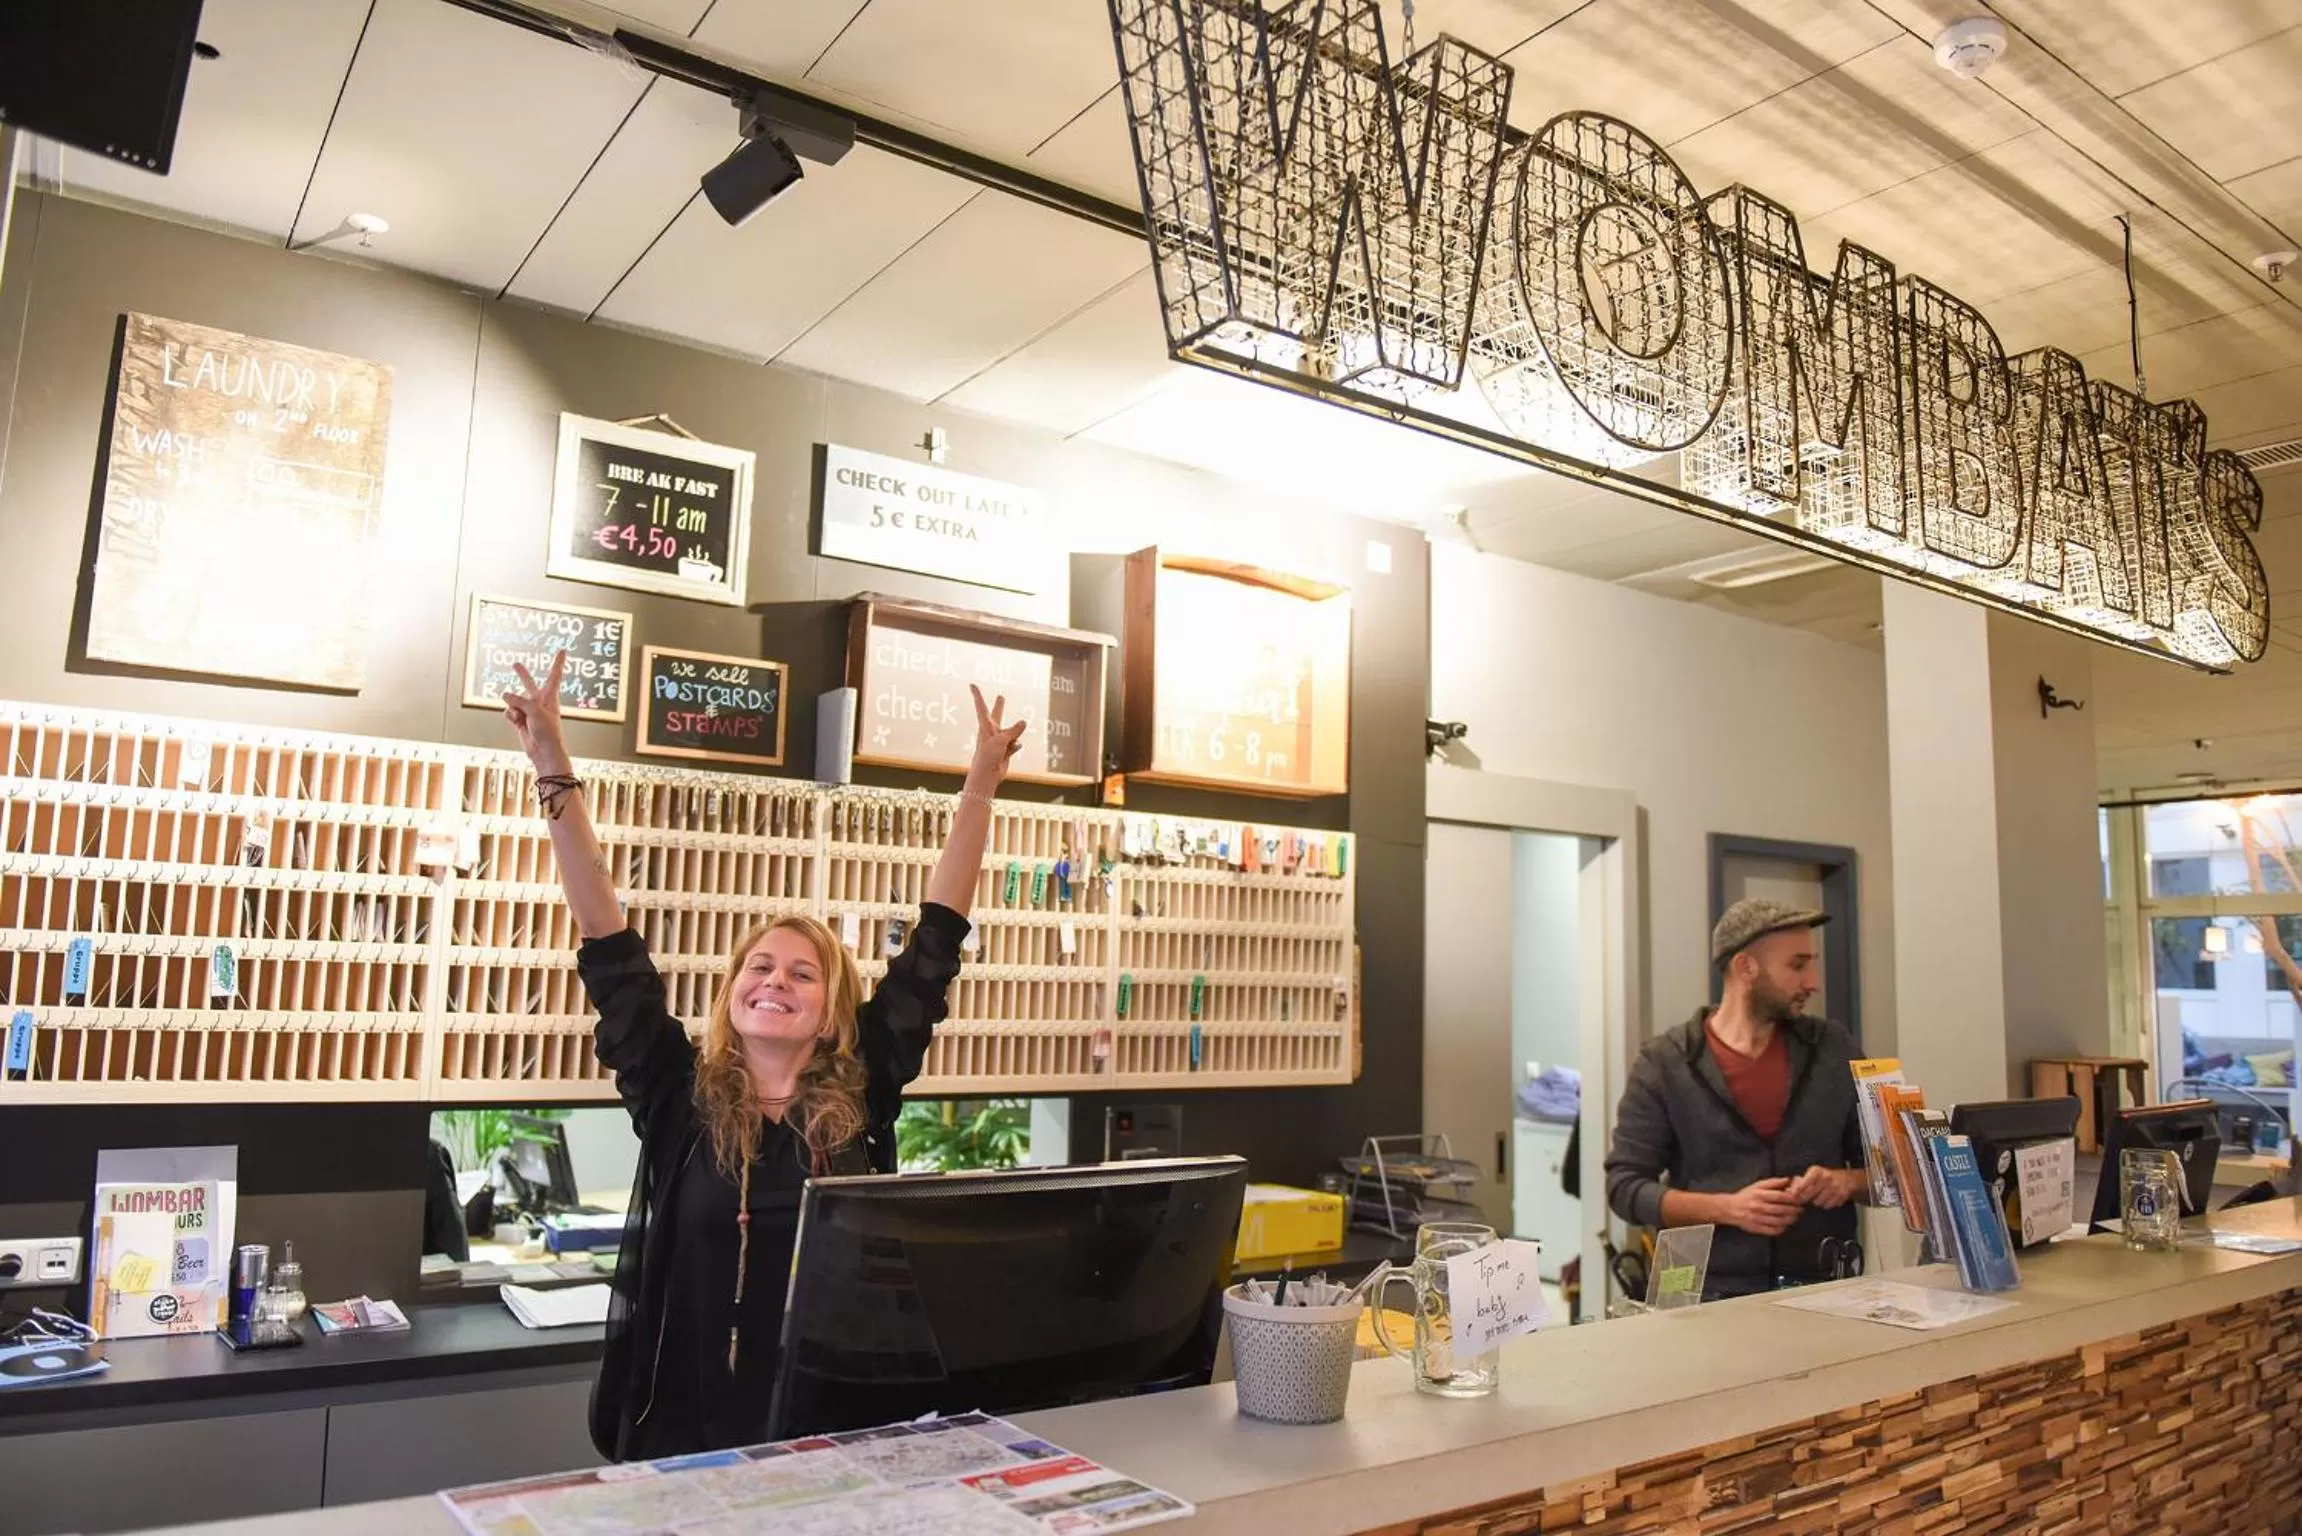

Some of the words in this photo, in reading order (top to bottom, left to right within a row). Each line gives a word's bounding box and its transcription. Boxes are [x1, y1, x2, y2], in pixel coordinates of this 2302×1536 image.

[163, 345, 348, 414] LAUNDRY
[131, 423, 205, 462] WASH
[234, 409, 259, 428] ON
[313, 424, 360, 446] FLOOR
[607, 462, 720, 499] BREAKFAST
[836, 467, 907, 498] CHECK
[917, 484, 957, 507] OUT
[595, 483, 621, 517] 7
[675, 506, 708, 535] am
[915, 513, 981, 542] EXTRA
[704, 665, 749, 686] sell
[875, 634, 959, 678] check
[1052, 675, 1075, 695] am
[875, 684, 959, 726] check
[111, 1187, 206, 1214] WOMBAR
[173, 1213, 204, 1229] URS
[177, 1255, 206, 1270] Beer
[1472, 1252, 1495, 1289] Tip
